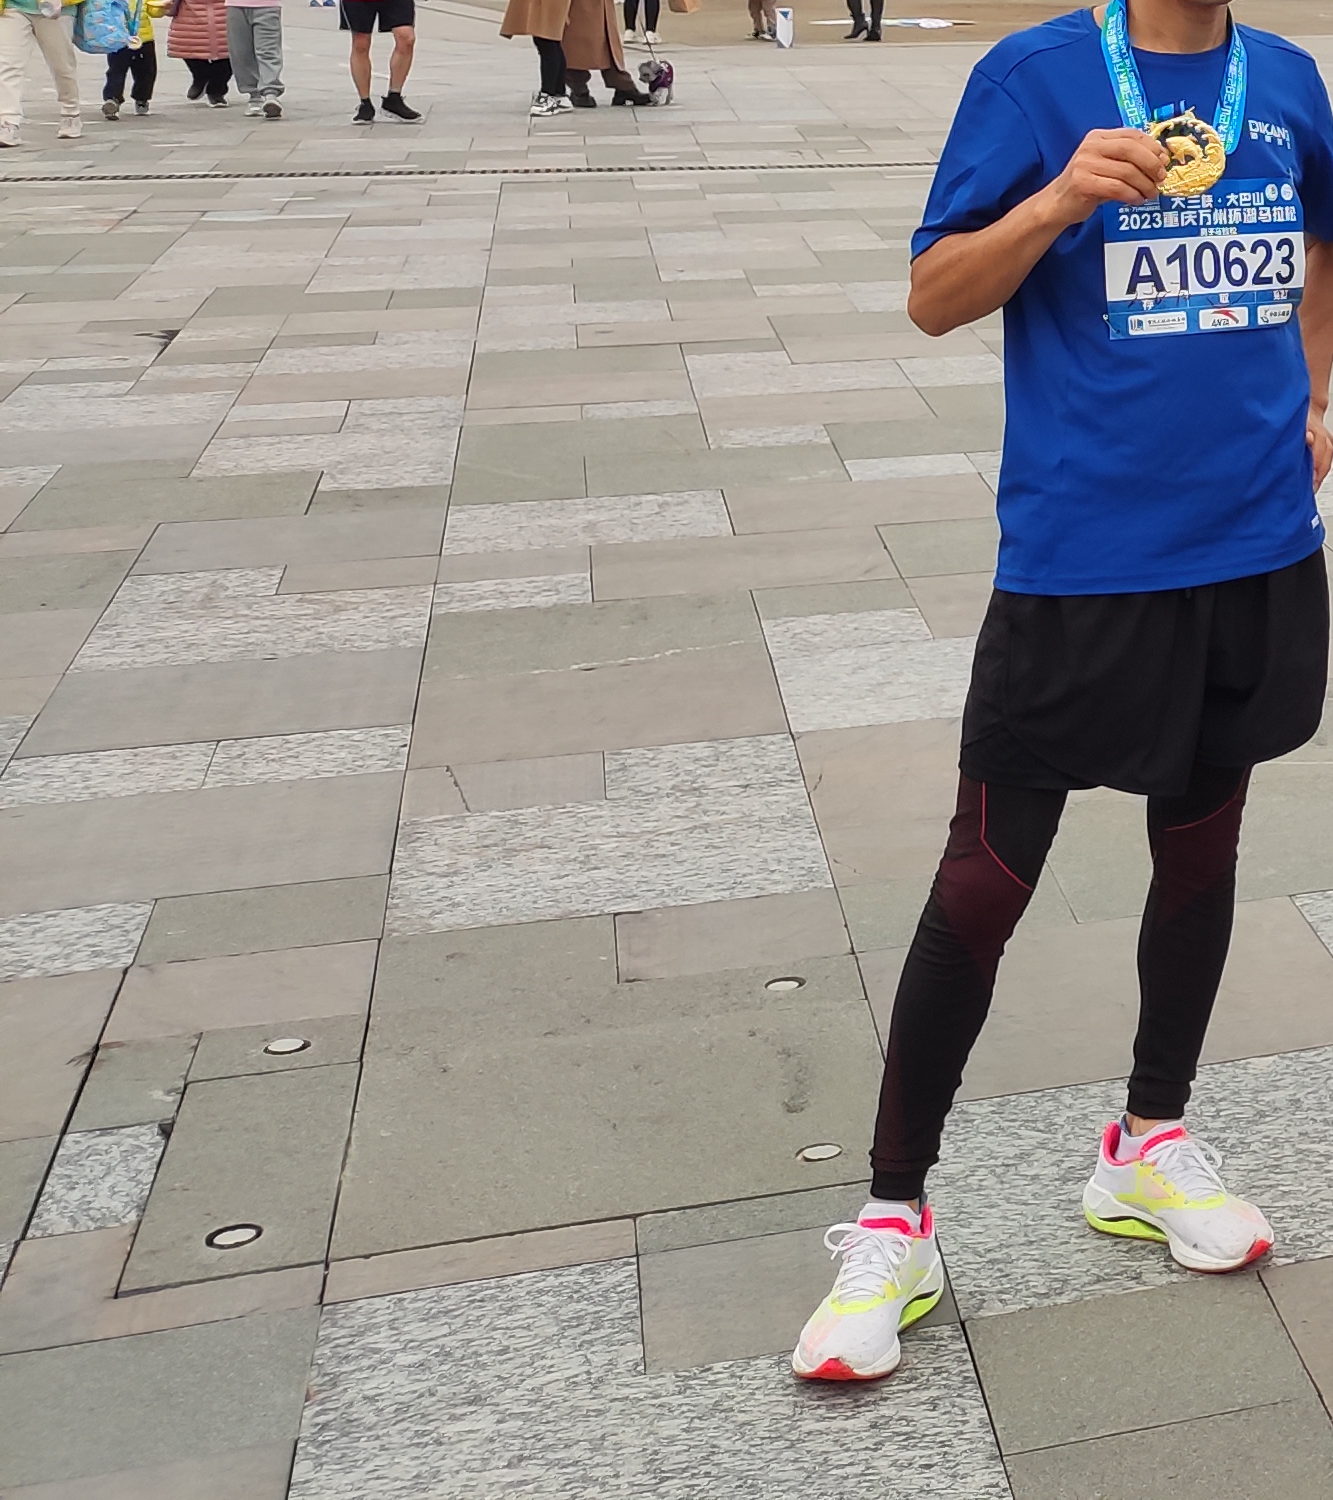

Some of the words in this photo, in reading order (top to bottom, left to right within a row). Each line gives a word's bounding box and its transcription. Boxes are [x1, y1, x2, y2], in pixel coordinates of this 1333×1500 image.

[1118, 206, 1297, 231] 2023重庆万州环湖马拉松
[1125, 237, 1295, 295] A10623
